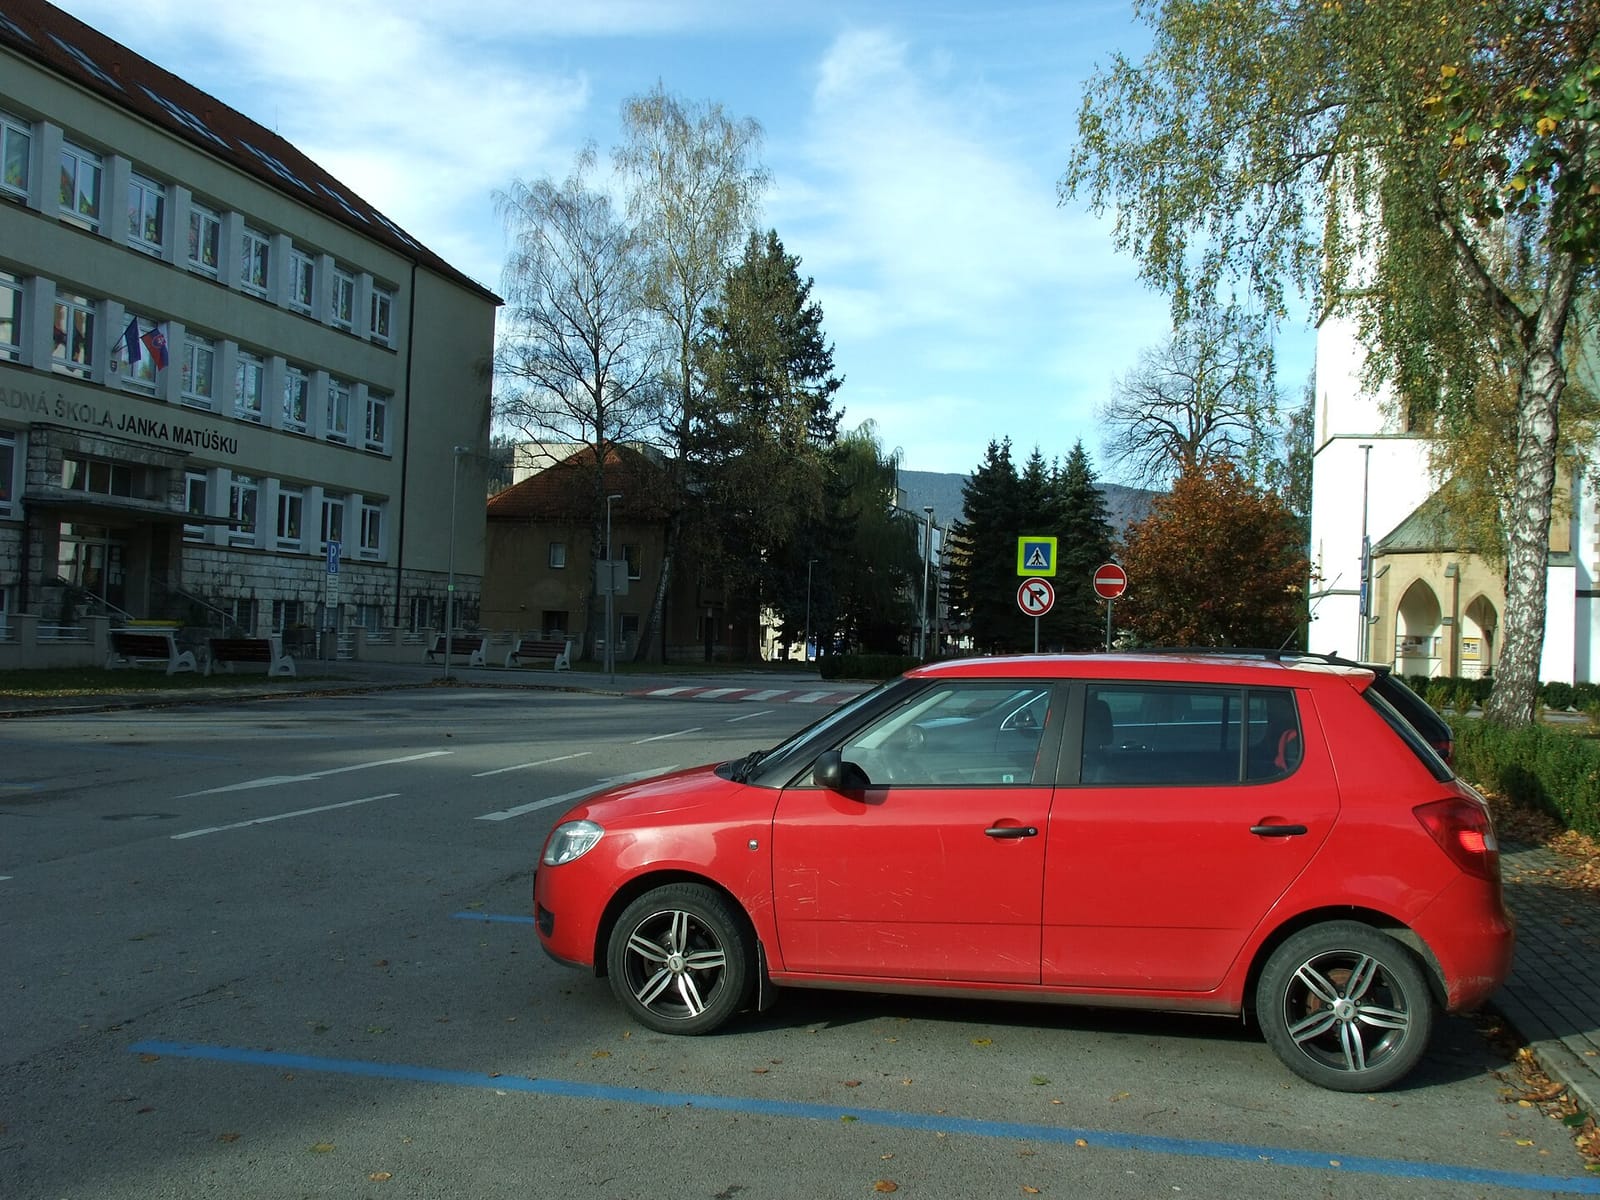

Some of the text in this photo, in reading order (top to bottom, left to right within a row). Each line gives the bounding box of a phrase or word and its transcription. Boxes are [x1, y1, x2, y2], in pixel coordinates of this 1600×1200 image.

[55, 393, 113, 429] ŠKOLA
[117, 414, 168, 441] JANKA
[172, 425, 238, 455] MATÚŠKU
[329, 544, 337, 563] P
